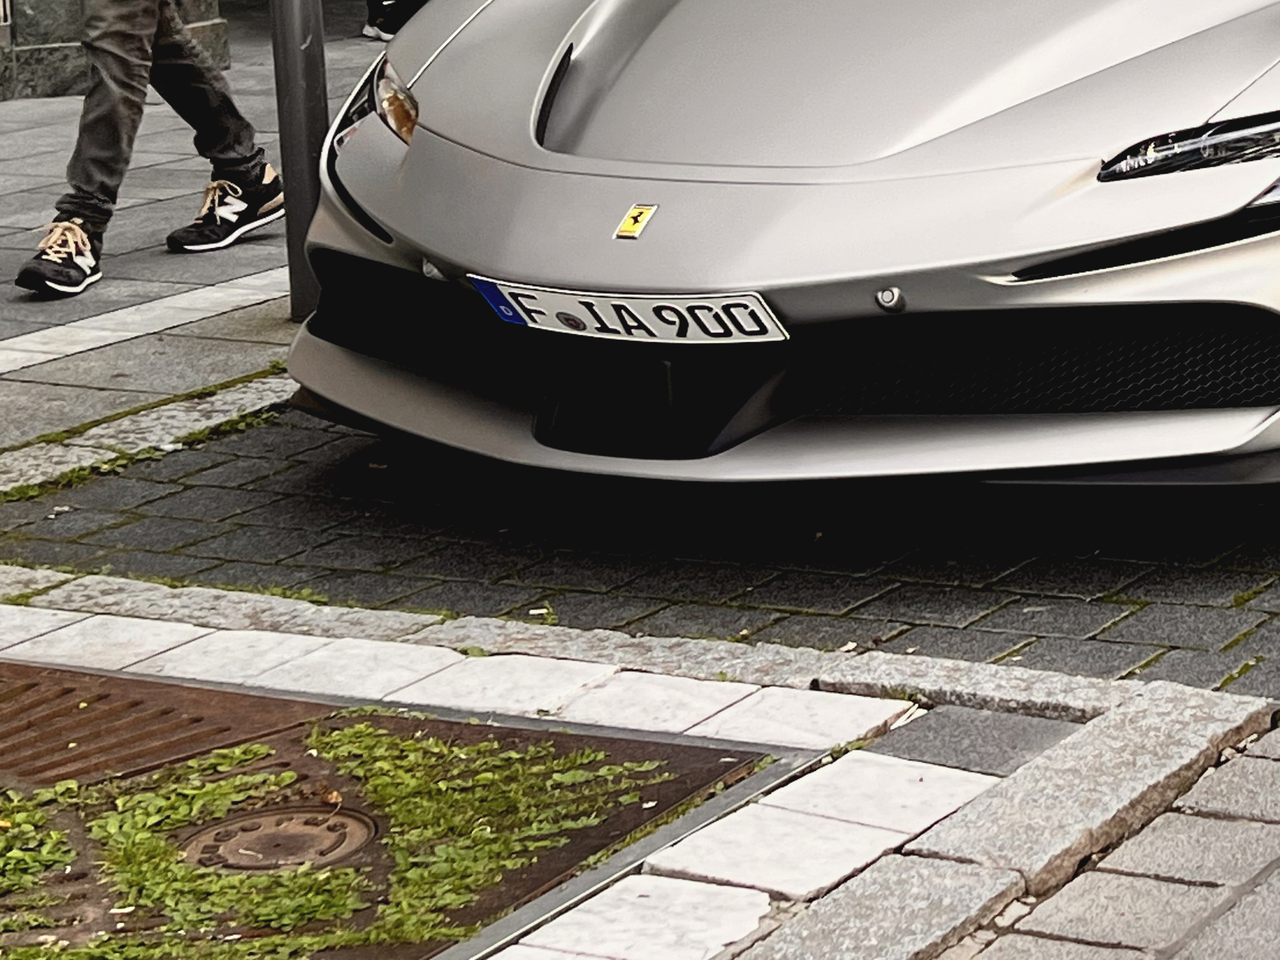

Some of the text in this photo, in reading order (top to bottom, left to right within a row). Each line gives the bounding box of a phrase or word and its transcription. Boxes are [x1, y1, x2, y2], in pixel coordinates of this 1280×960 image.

[508, 292, 769, 337] F IA 900
